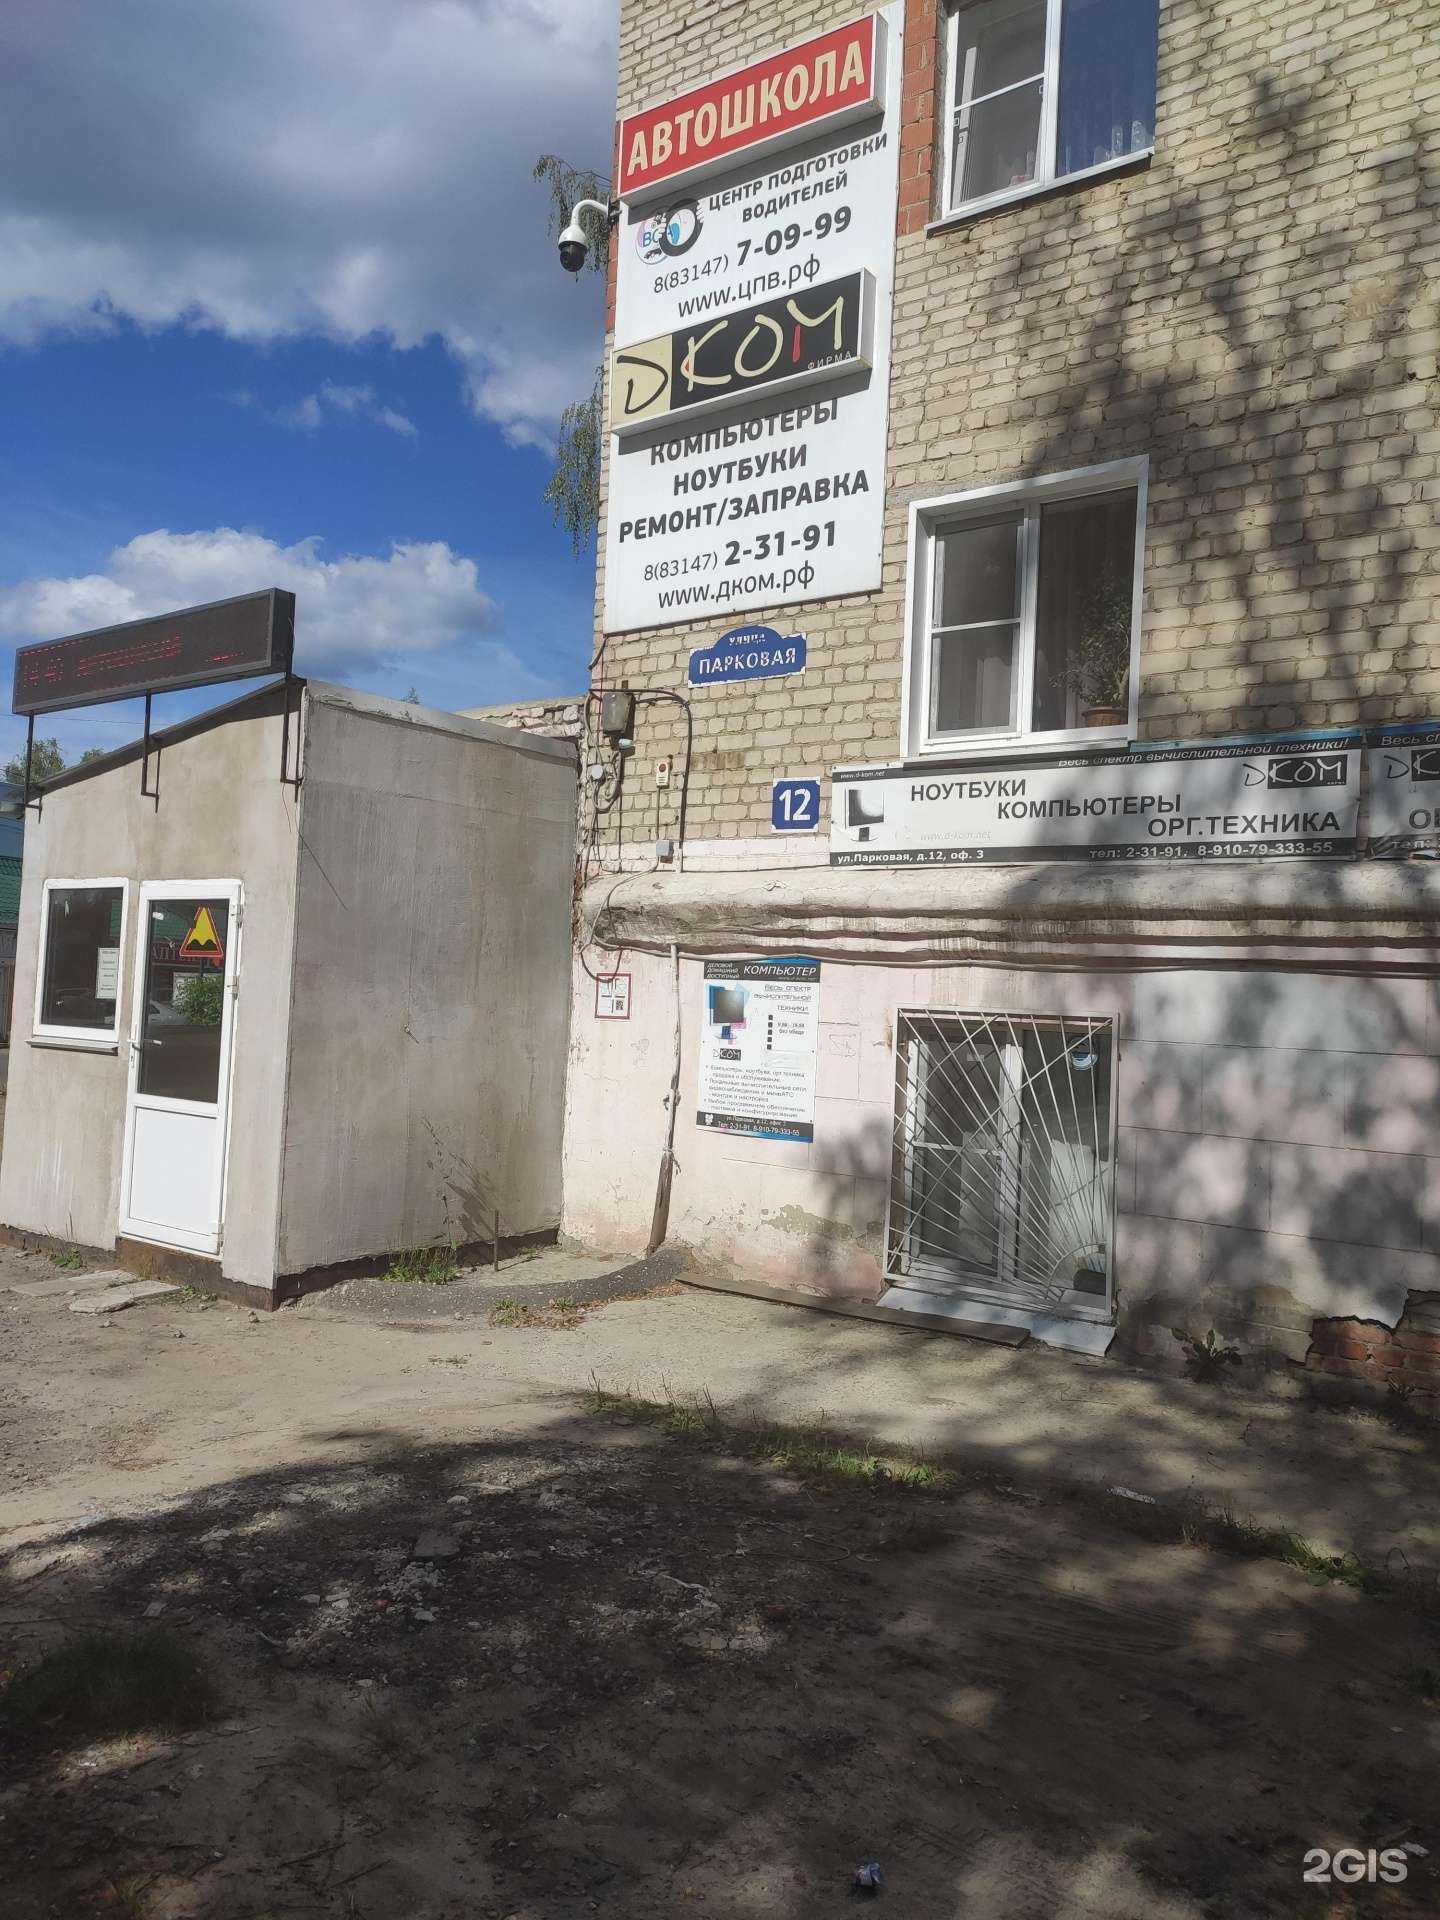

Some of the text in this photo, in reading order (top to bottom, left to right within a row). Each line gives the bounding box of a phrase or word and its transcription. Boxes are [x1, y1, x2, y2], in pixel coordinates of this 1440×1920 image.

[627, 40, 864, 177] АВТОШКОЛА
[709, 133, 888, 211] ЦЕНТР ПОДГОТОВКИ
[742, 170, 848, 223] ВОДИТЕЛЕЙ
[654, 206, 852, 293] 8(83147) 7-09-99
[678, 254, 820, 317] www.цпв.рф
[650, 398, 838, 465] КОМПЬЮТЕРЫ
[674, 444, 808, 496] НОУТБУКИ
[619, 469, 869, 543] РЕМОНТ/ЗАПРАВКА
[644, 520, 836, 582] 8(83147) 2-31-91
[658, 560, 815, 608] www.дком.рф
[699, 647, 796, 674] ПАРКОВАЯ
[1146, 744, 1271, 762] вычислительной
[1276, 738, 1350, 754] техники!
[1381, 735, 1420, 746] Весь
[778, 788, 811, 821] 12
[911, 779, 1026, 801] НОУТБУКИ
[998, 795, 1181, 819] КОМПЬЮТЕРЫ
[1148, 812, 1340, 837] ОРГ.ТЕХНИКА
[976, 850, 984, 859] 3
[1198, 841, 1333, 856] 8-910-79-333-55
[743, 965, 817, 976] КОМПЬЮТЕР
